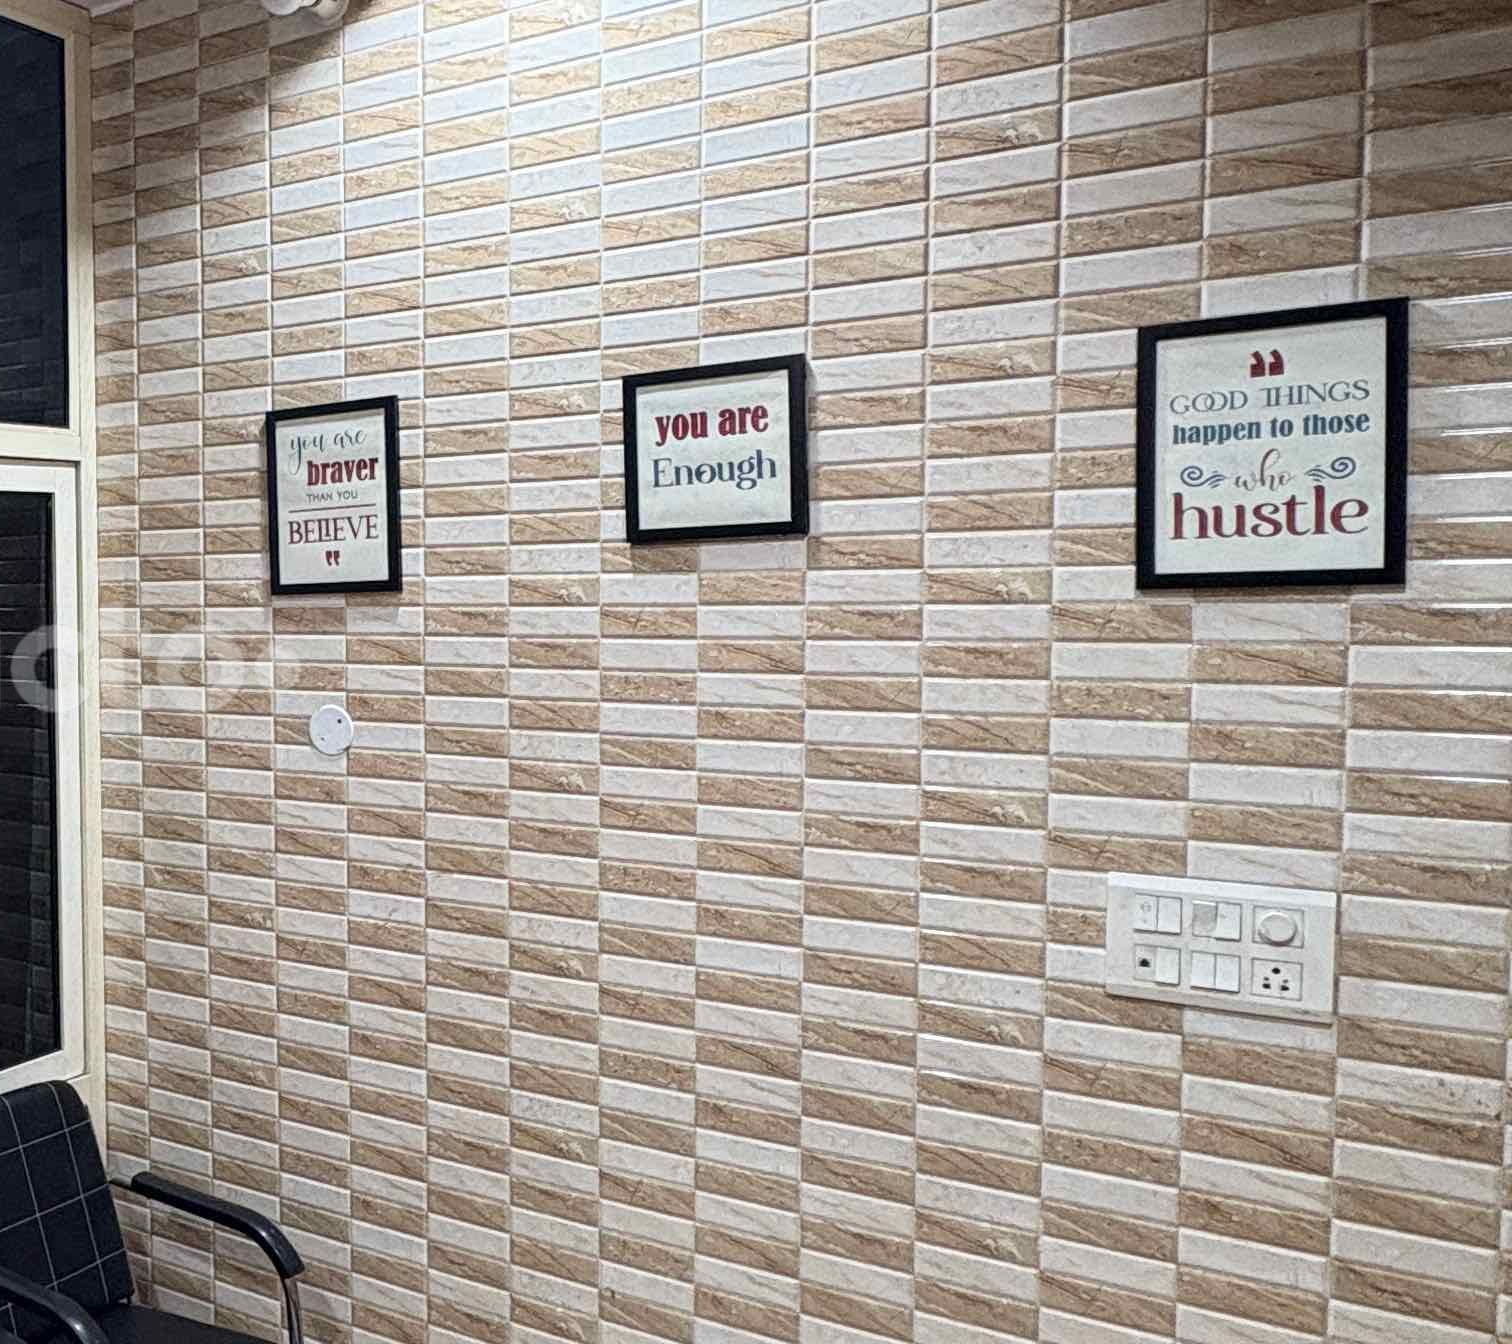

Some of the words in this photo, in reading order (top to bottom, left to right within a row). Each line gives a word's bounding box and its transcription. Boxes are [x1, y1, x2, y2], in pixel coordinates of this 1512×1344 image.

[1169, 390, 1248, 415] GOOD
[1258, 379, 1370, 408] THINGS
[654, 411, 709, 447] you
[717, 405, 769, 436] are
[1172, 418, 1262, 446] happen
[1269, 417, 1294, 439] to
[1302, 412, 1370, 436] those
[289, 432, 325, 476] you
[333, 428, 367, 450] are
[652, 449, 777, 490] Enough
[1233, 448, 1295, 491] who
[306, 457, 379, 486] braver
[305, 491, 333, 505] THAN
[337, 489, 359, 501] YOU
[1169, 484, 1369, 540] hustle
[288, 514, 380, 545] BELIEVE
